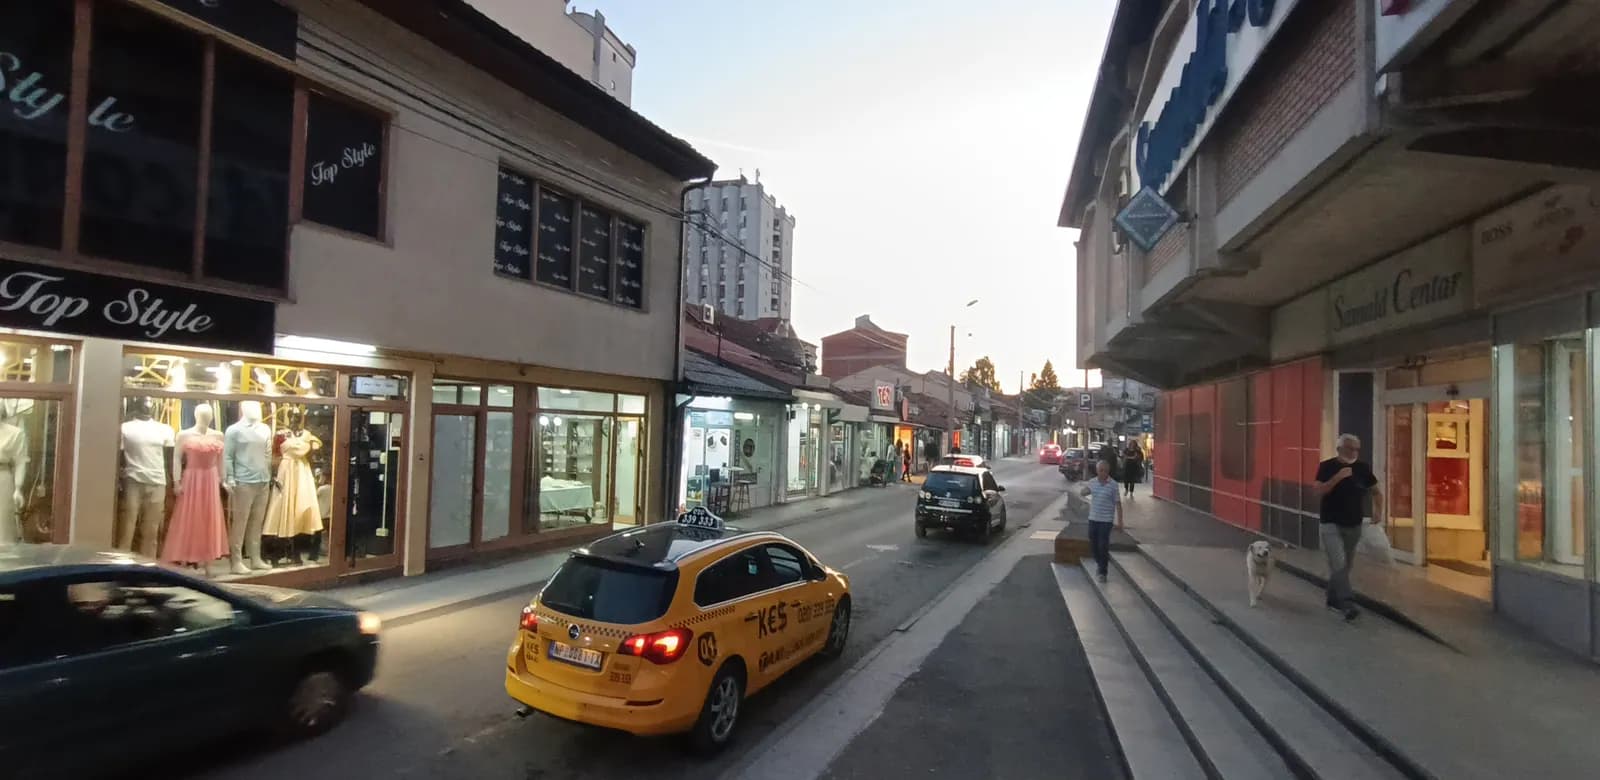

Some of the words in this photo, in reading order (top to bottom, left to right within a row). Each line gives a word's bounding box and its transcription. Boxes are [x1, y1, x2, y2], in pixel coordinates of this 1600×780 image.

[311, 160, 339, 187] Top
[341, 141, 376, 168] Style
[0, 271, 90, 327] Top
[103, 288, 216, 339] Style
[1393, 268, 1462, 314] Centar
[1081, 394, 1091, 406] P
[681, 514, 697, 524] 339
[698, 516, 714, 527] 333
